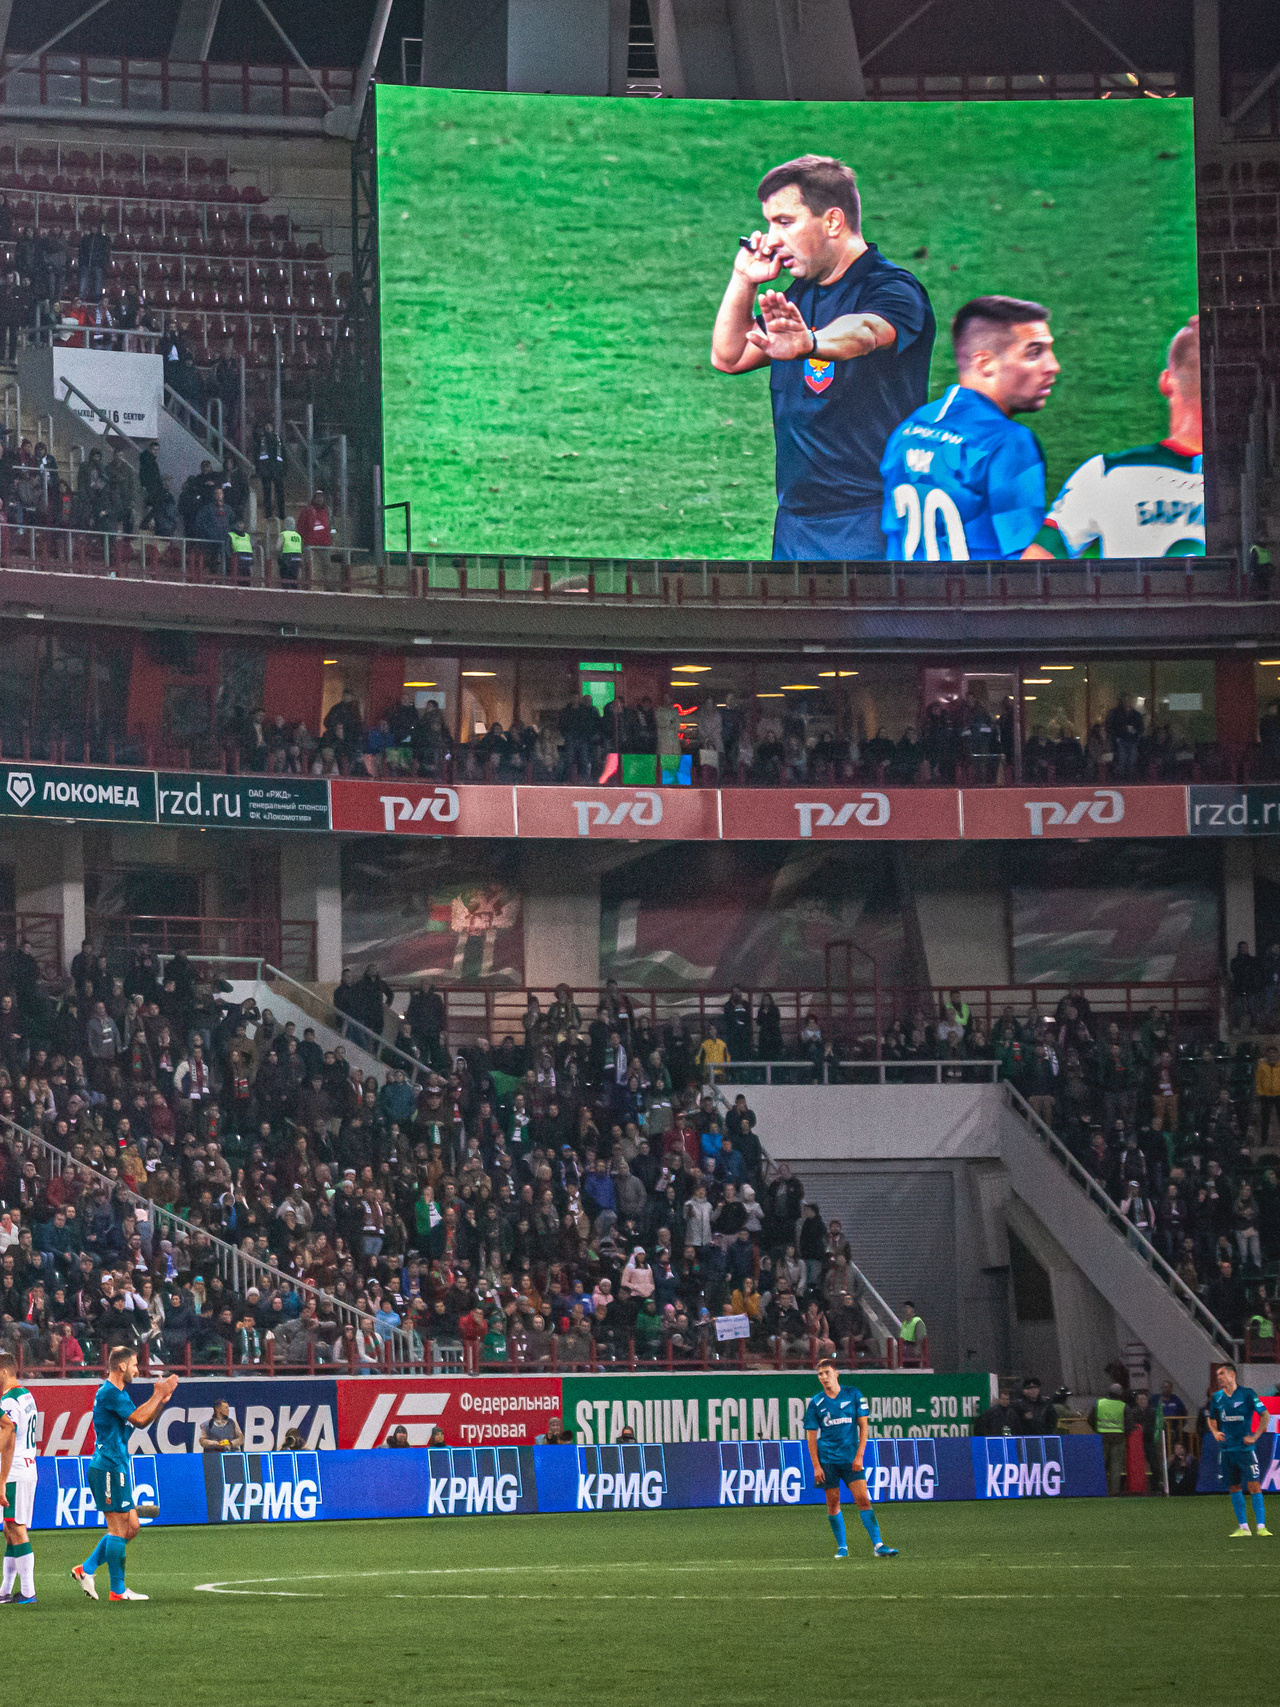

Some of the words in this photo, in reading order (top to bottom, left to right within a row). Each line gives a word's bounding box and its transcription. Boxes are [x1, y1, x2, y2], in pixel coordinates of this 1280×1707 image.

[123, 412, 145, 420] СЕКТОР
[43, 781, 140, 808] ЛОКОМЕД
[159, 782, 241, 818] rzd.ru
[248, 789, 264, 798] ОАО
[249, 802, 296, 812] генеральный
[298, 803, 327, 814] спонсор
[249, 812, 261, 820] ФК
[1195, 794, 1280, 825] rzd.r
[460, 1392, 560, 1416] Федеральная
[930, 1396, 958, 1418] ЭТО
[962, 1396, 981, 1418] НЕ
[25, 1414, 37, 1450] 18
[460, 1423, 526, 1443] грузовая
[427, 1473, 519, 1515] KPMG
[577, 1471, 663, 1510] KPMG
[720, 1466, 802, 1505] KPMG
[986, 1461, 1062, 1497] KPMG
[55, 1483, 155, 1527] KPG
[221, 1479, 318, 1521] KPMG
